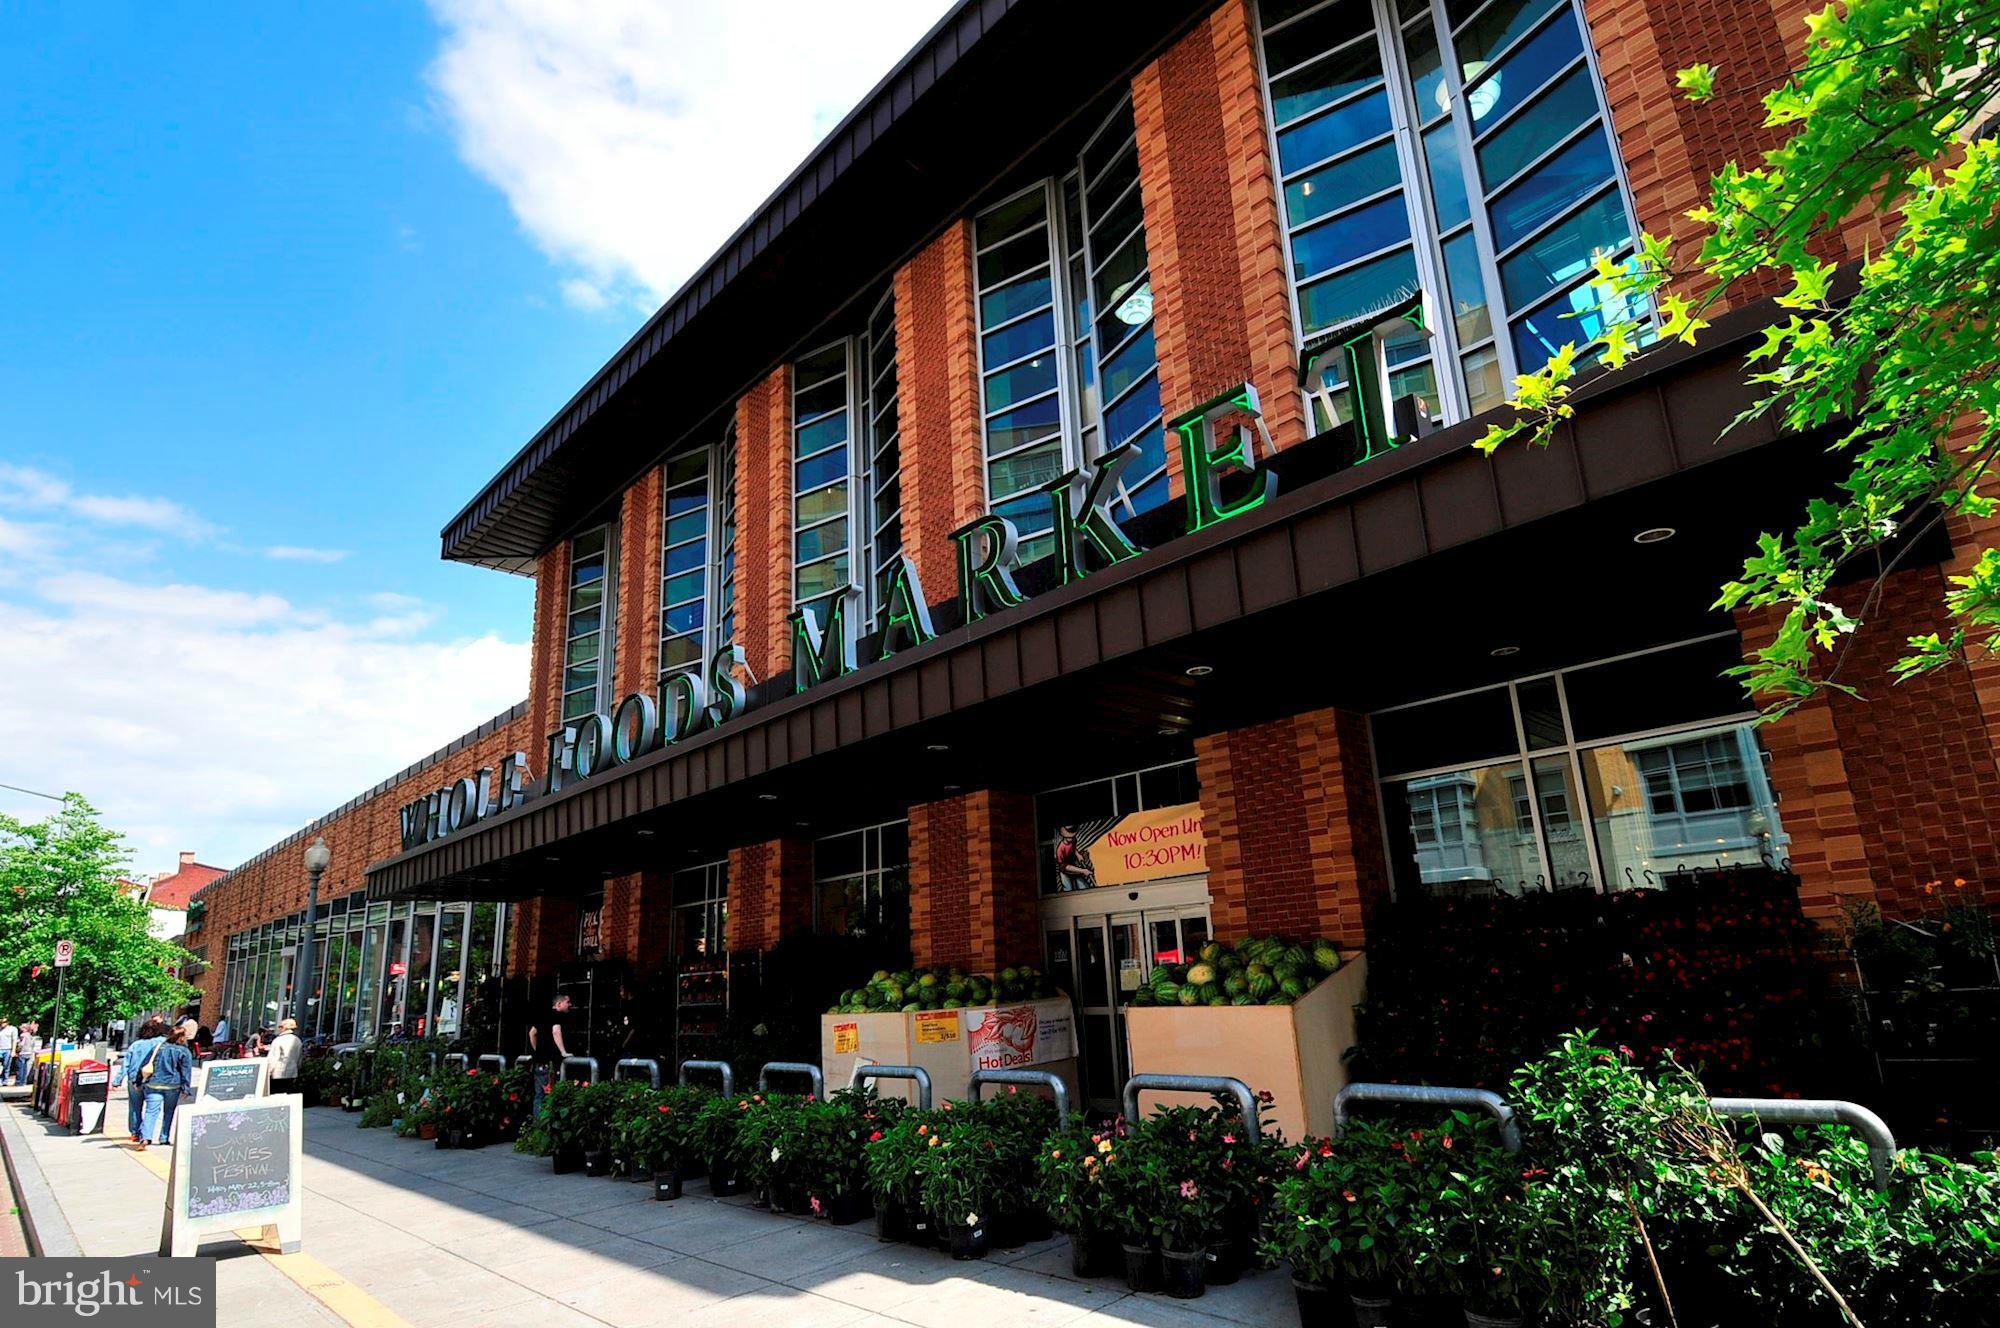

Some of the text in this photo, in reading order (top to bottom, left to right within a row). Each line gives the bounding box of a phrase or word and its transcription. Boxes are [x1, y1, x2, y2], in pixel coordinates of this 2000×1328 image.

[400, 290, 1435, 848] WHOLE FOODS MARKET
[1108, 817, 1203, 848] Now Open Un
[1124, 842, 1201, 870] 10:30PM!
[979, 1051, 1034, 1071] Hot Deals!
[212, 1146, 273, 1163] WINES
[212, 1163, 275, 1184] FESTIVAL
